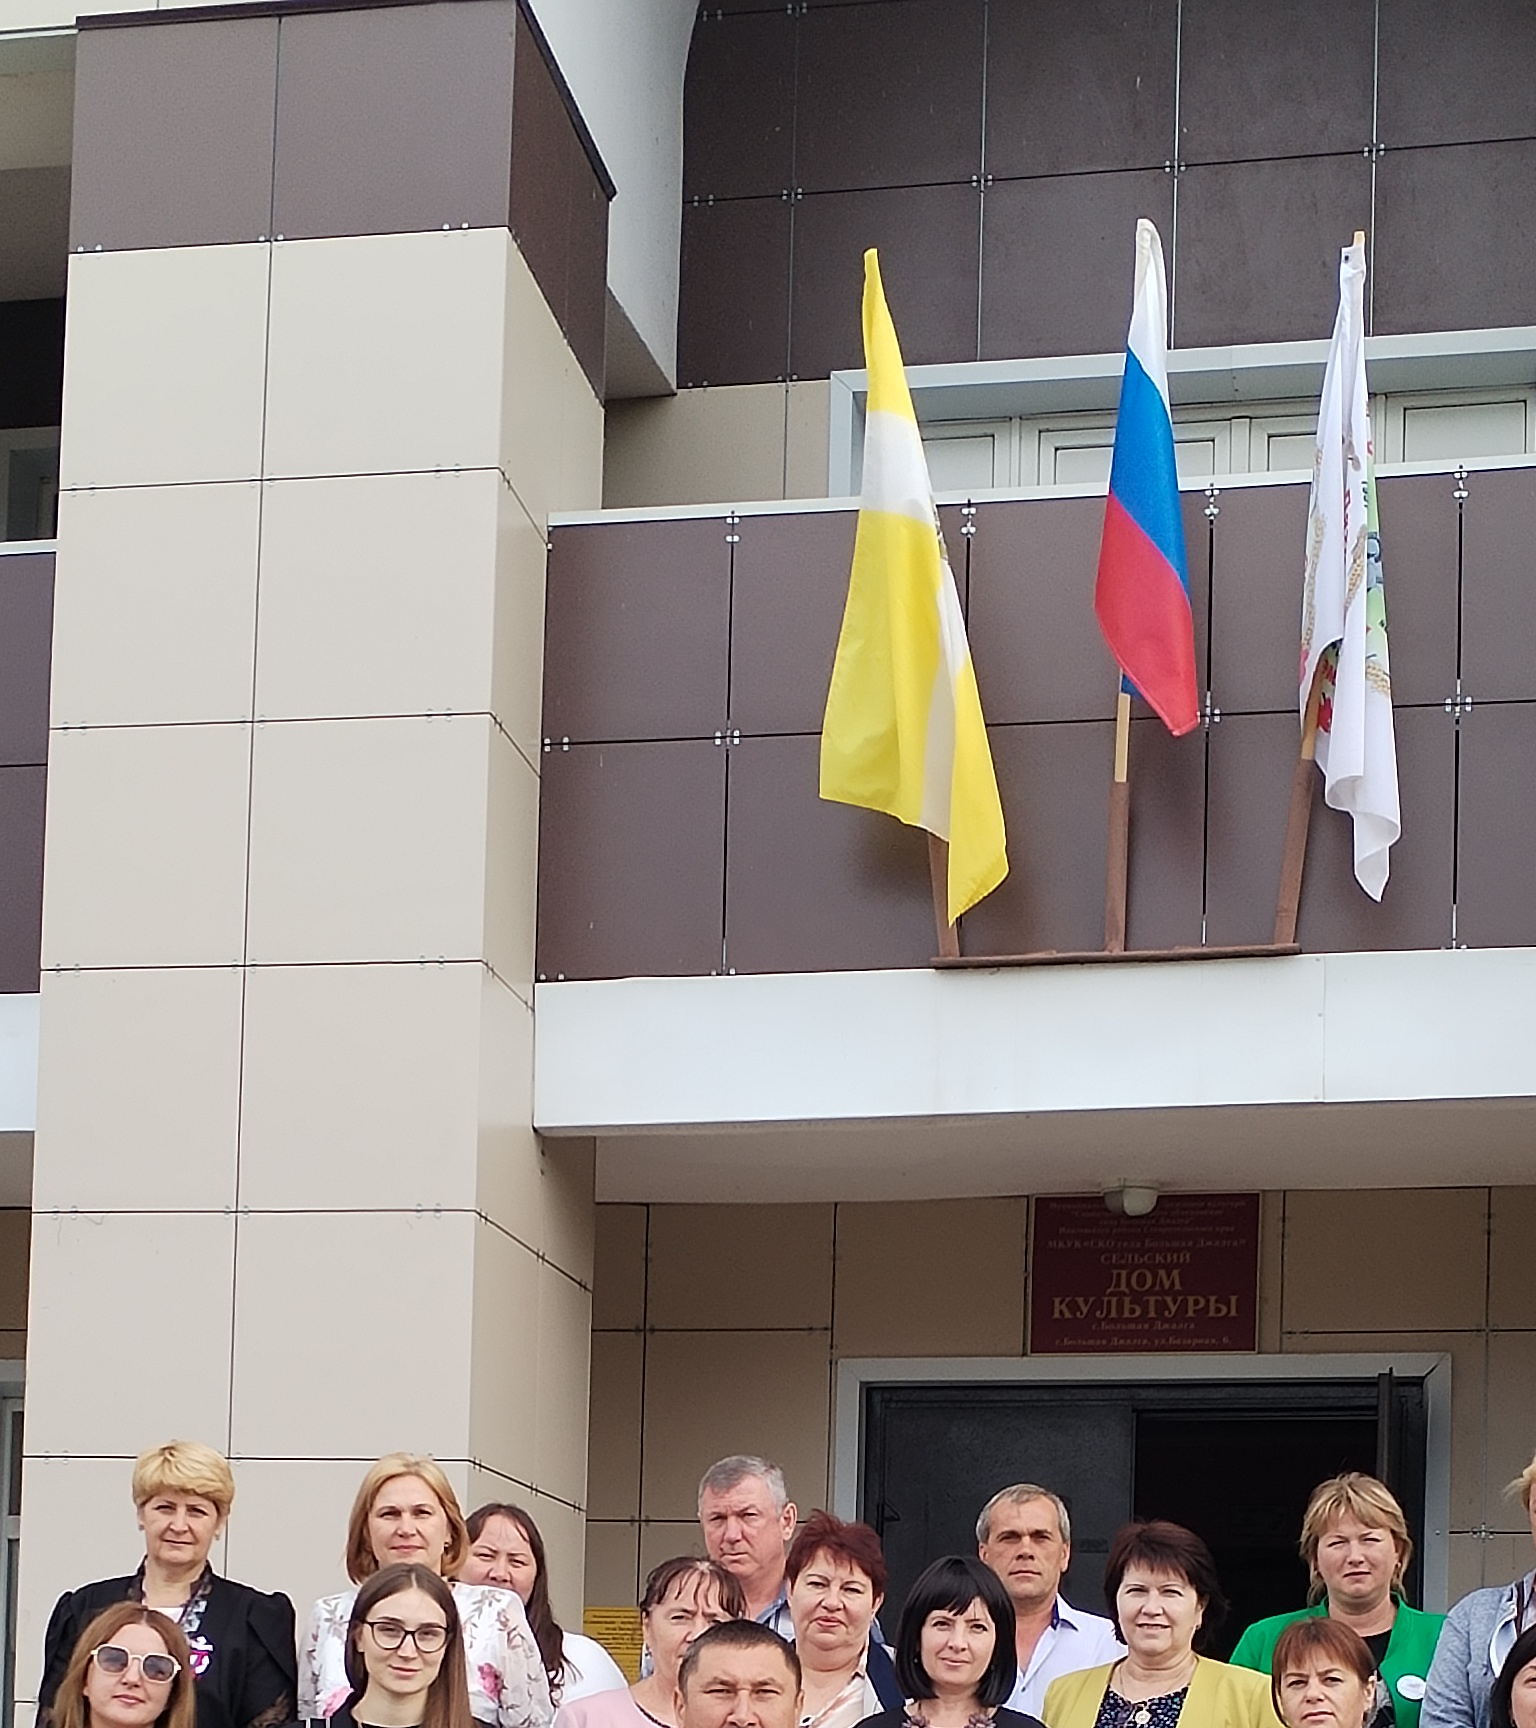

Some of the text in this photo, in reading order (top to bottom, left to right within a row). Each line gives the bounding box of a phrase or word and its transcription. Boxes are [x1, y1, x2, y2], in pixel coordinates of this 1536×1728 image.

[1100, 1252, 1191, 1265] СЕЛЬСКИЙ
[1106, 1268, 1183, 1295] ДОМ
[1052, 1295, 1239, 1319] КУЛЬТУРЫ
